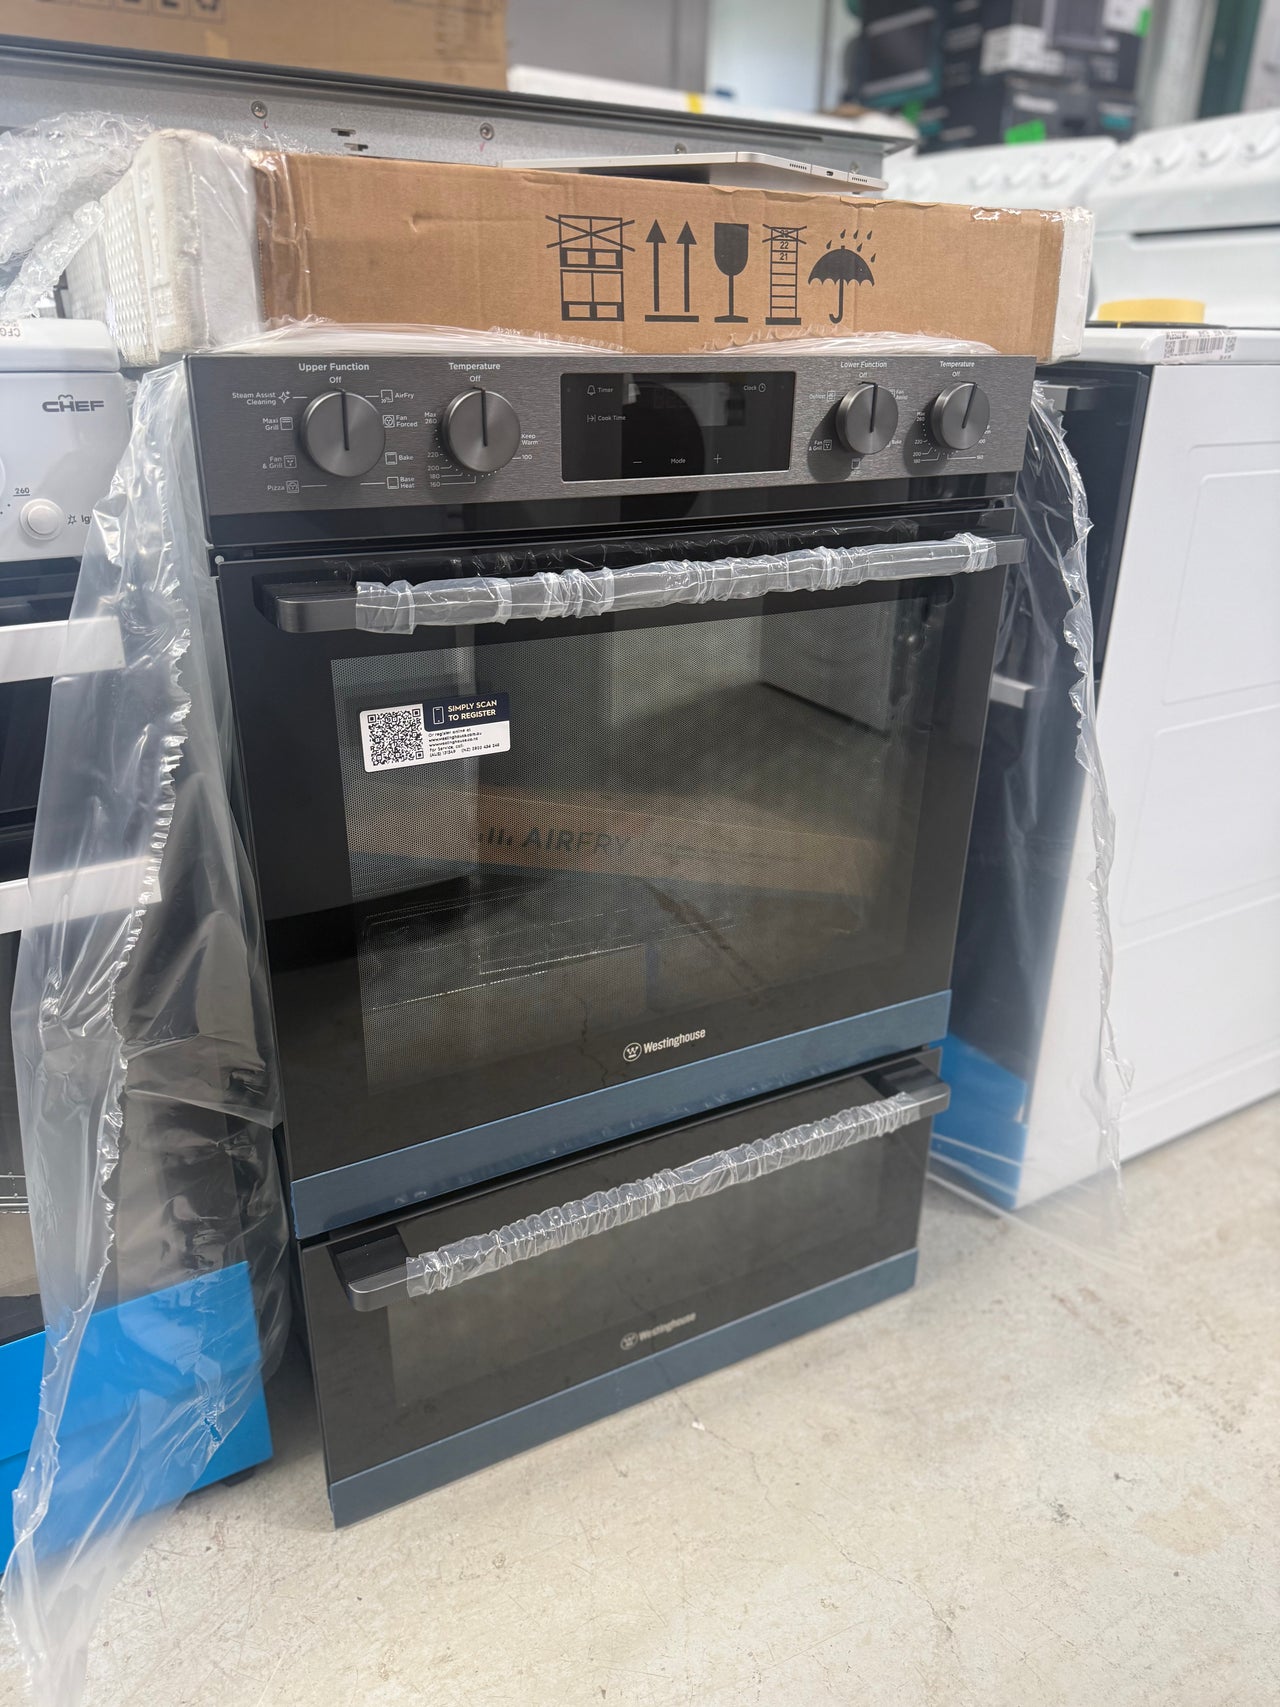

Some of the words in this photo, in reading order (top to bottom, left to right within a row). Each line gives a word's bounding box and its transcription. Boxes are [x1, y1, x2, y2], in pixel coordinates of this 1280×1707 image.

[780, 241, 789, 249] 22
[779, 252, 788, 261] 21
[298, 363, 328, 373] Upper
[329, 362, 370, 371] Function
[448, 362, 501, 371] Temperature
[940, 360, 975, 368] Temperature
[329, 376, 342, 384] Off
[255, 391, 276, 399] Assist
[394, 391, 415, 400] AirFry
[42, 400, 105, 412] CHEF
[395, 414, 408, 422] Fan
[264, 423, 280, 431] Grill
[396, 420, 418, 428] Forced
[269, 456, 282, 464] Fan
[448, 703, 474, 712] SIMPLY
[476, 700, 497, 708] SCAN
[461, 709, 496, 719] REGISTER
[521, 824, 630, 858] AIRFRY
[643, 1028, 706, 1054] Westinghouse
